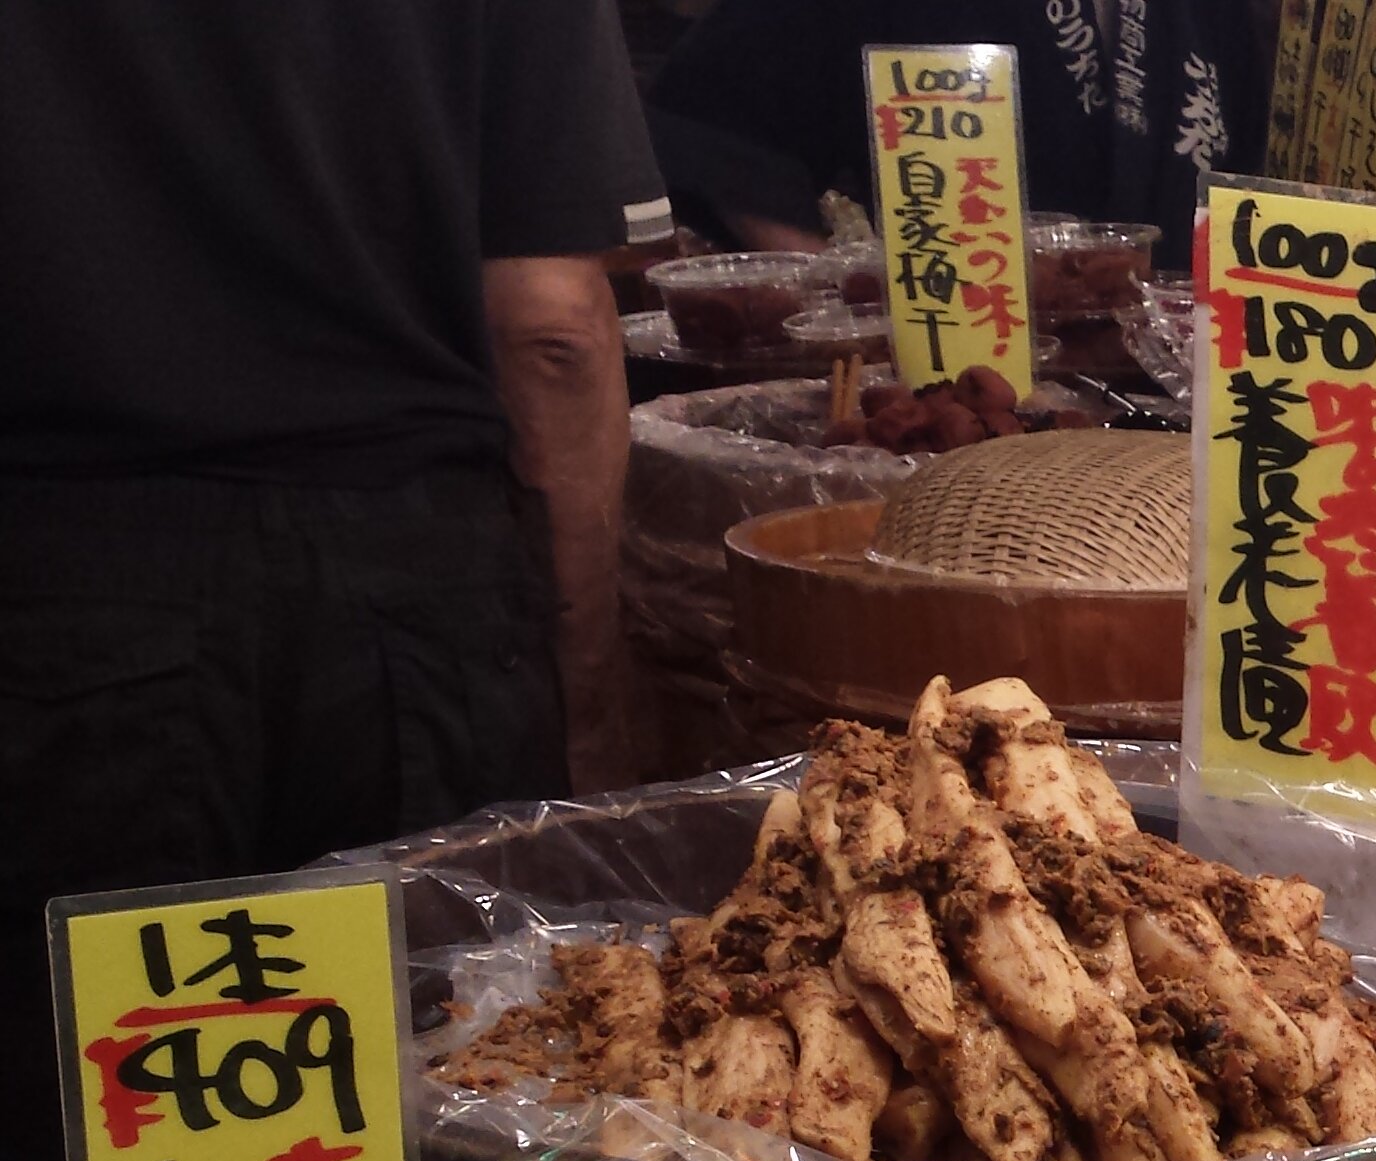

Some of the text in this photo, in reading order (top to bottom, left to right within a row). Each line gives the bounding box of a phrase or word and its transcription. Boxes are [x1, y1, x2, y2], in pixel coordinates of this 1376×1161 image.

[875, 104, 984, 150] ¥210
[891, 60, 990, 102] 100g
[895, 152, 973, 371] 自家梅干
[140, 910, 305, 1004] 1本
[85, 1003, 367, 1148] ¥409
